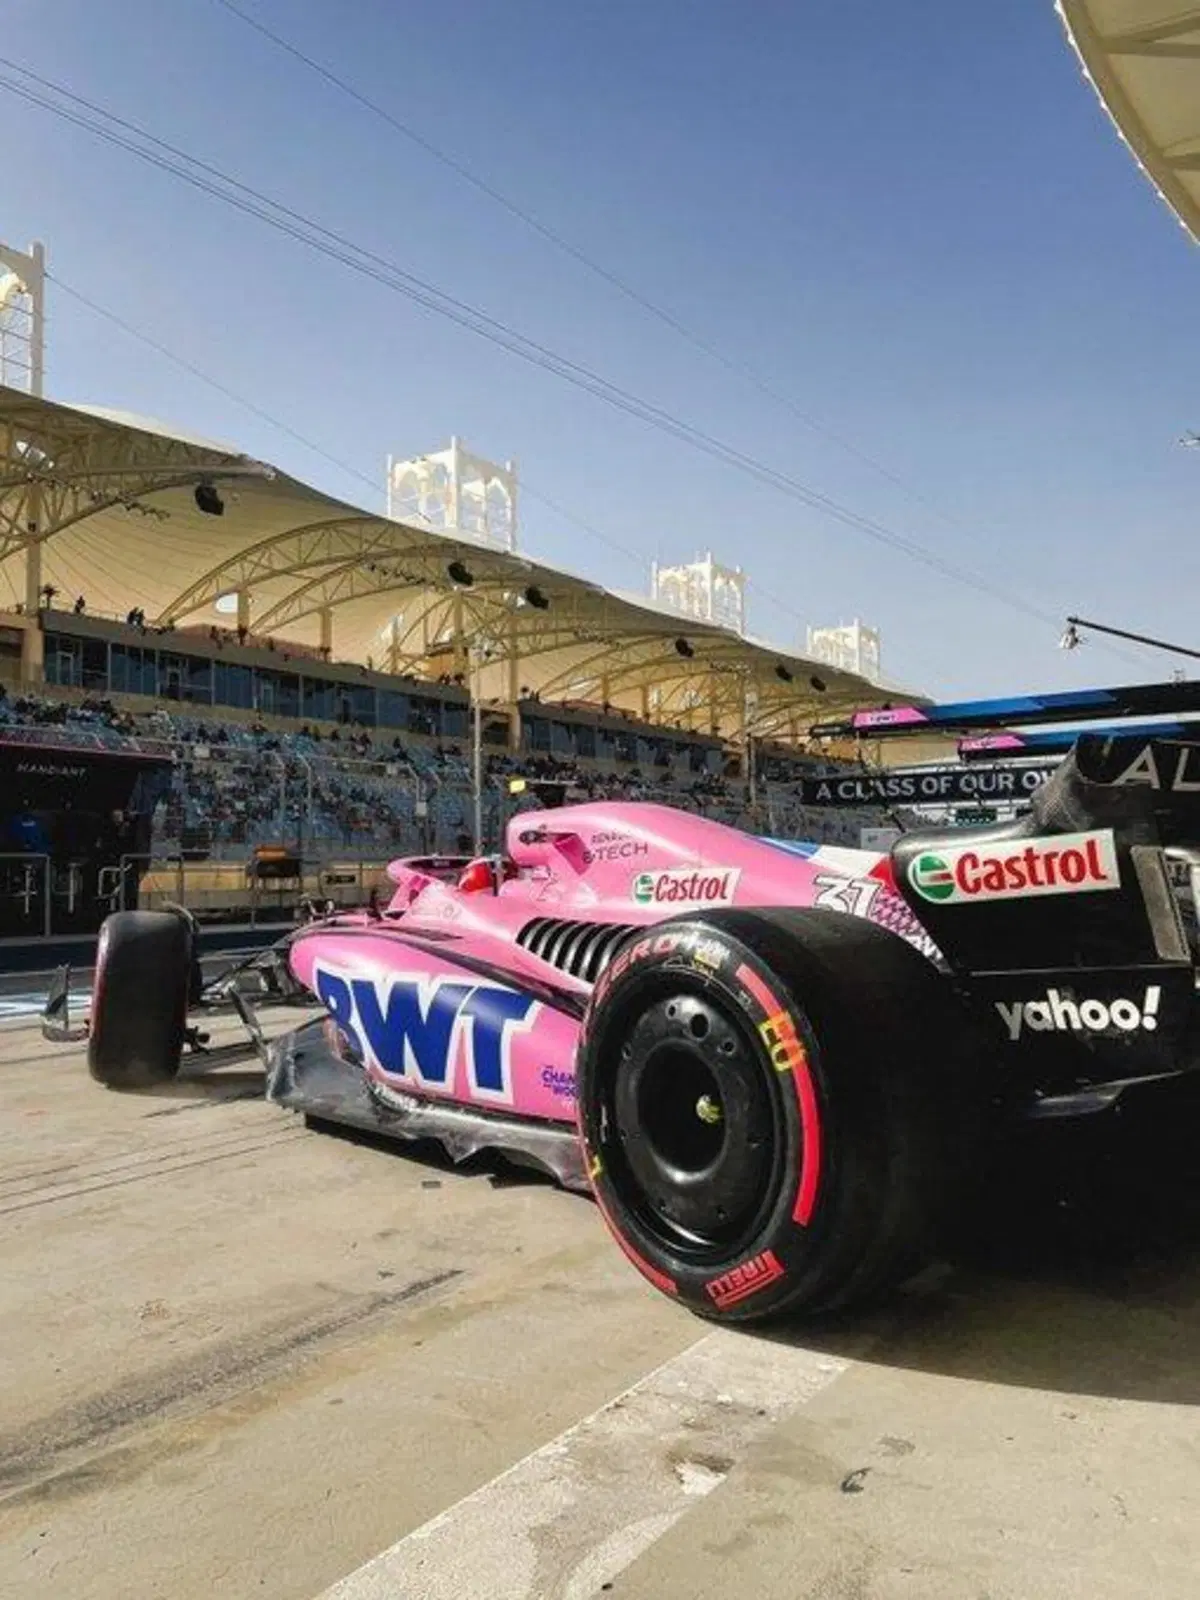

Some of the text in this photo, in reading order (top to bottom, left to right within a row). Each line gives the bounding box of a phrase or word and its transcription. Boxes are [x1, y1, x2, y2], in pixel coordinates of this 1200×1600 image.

[816, 783, 832, 800] A
[921, 775, 954, 795] OF
[960, 772, 1015, 793] OUR
[655, 872, 729, 902] Castrol
[955, 839, 1108, 895] Castrol
[314, 964, 538, 1097] BWT
[994, 985, 1161, 1041] yahoo!
